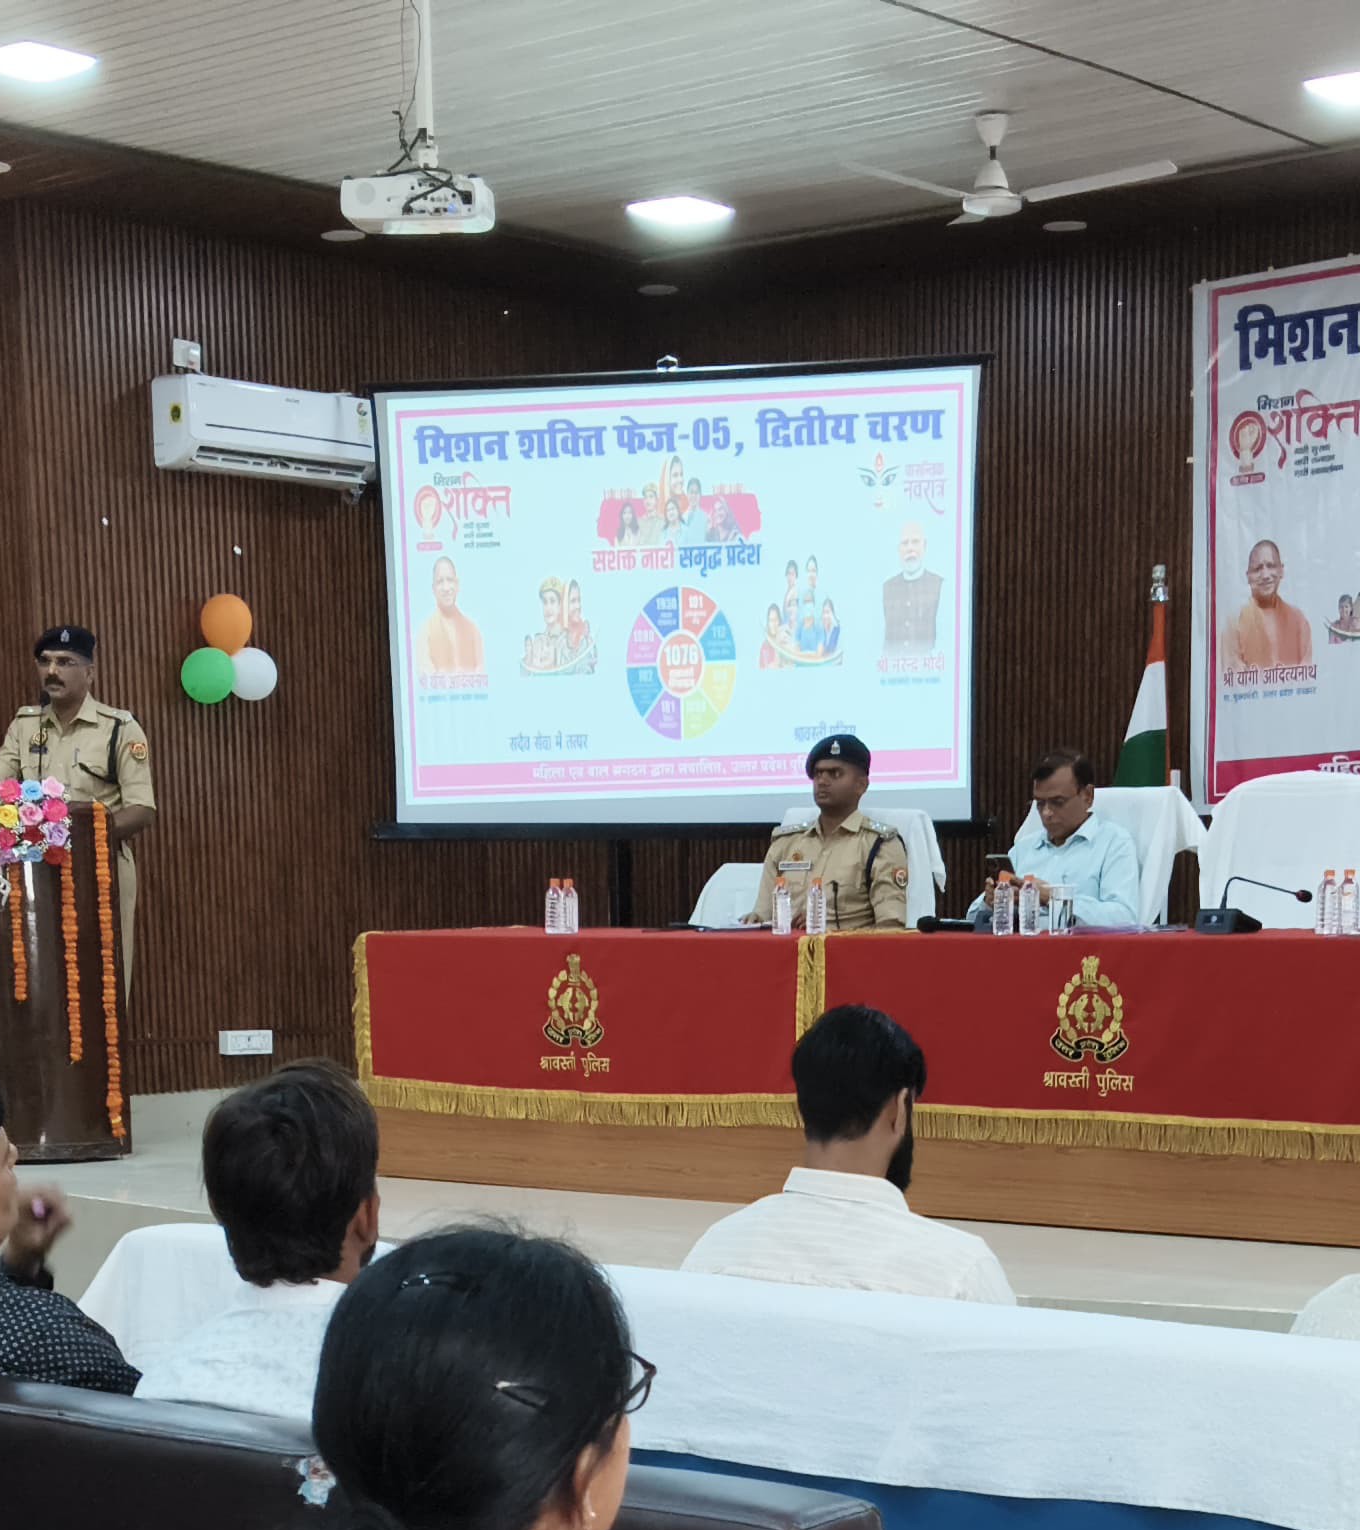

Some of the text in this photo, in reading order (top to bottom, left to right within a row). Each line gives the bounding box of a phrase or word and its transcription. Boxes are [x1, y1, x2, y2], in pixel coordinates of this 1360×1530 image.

[1257, 394, 1294, 411] मिशन
[414, 406, 946, 465] मिशन शक्ति फेज-05, द्वितीय चरण
[441, 471, 512, 541] शक्ति
[592, 537, 762, 578] सशक्त नारी समृद्ध प्रदेश
[663, 644, 699, 666] 1076
[1223, 663, 1318, 687] श्री योगी आदित्यनाथ
[539, 1050, 611, 1077] श्रावस्ती पुलिस
[1043, 1066, 1135, 1097] श्रावस्ती पुलिस
